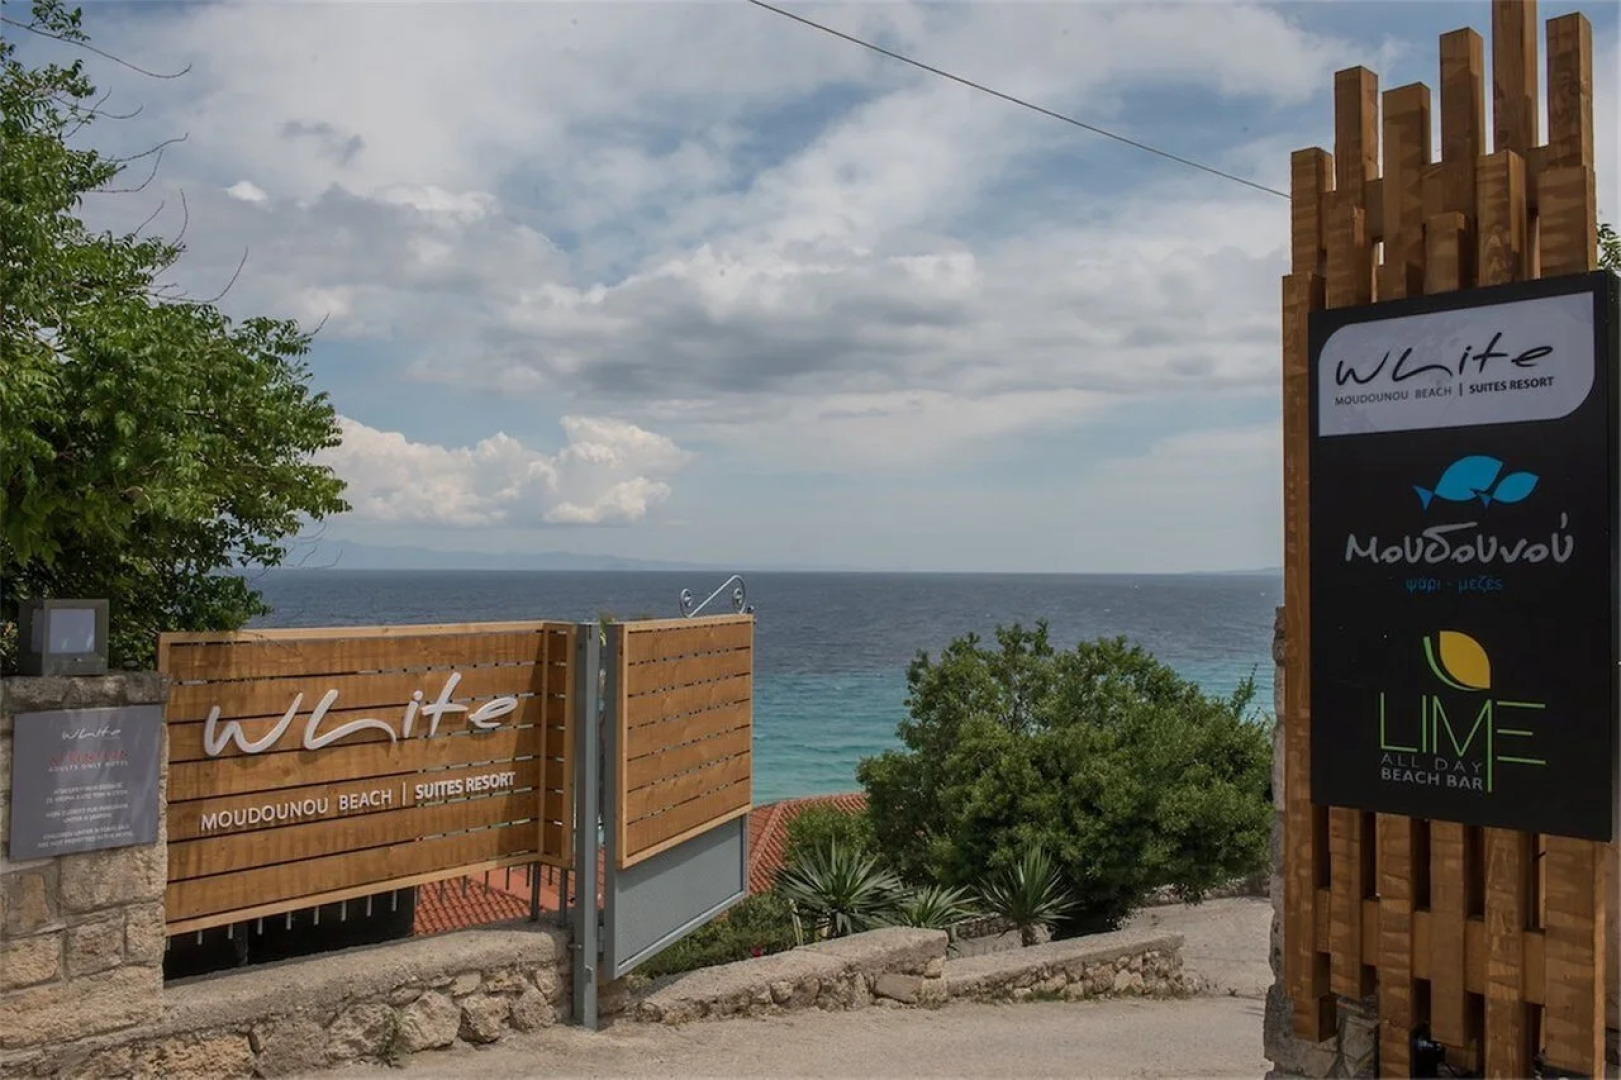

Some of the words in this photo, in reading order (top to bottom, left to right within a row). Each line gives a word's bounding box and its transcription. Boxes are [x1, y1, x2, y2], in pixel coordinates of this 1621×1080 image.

[1334, 391, 1408, 406] MOUDOUNOU
[1414, 386, 1452, 399] BEACH
[1469, 382, 1507, 395] SUITES
[1509, 376, 1555, 390] RESORT
[1379, 692, 1546, 792] LIME
[1380, 752, 1421, 768] ALL
[1434, 757, 1483, 774] DAY
[1381, 768, 1440, 787] BEACH
[1446, 774, 1484, 791] BAR
[200, 798, 329, 831] MOUDOUNOU
[338, 788, 393, 812] BEACH
[414, 780, 463, 801] SUITES
[465, 771, 516, 793] RESORT
